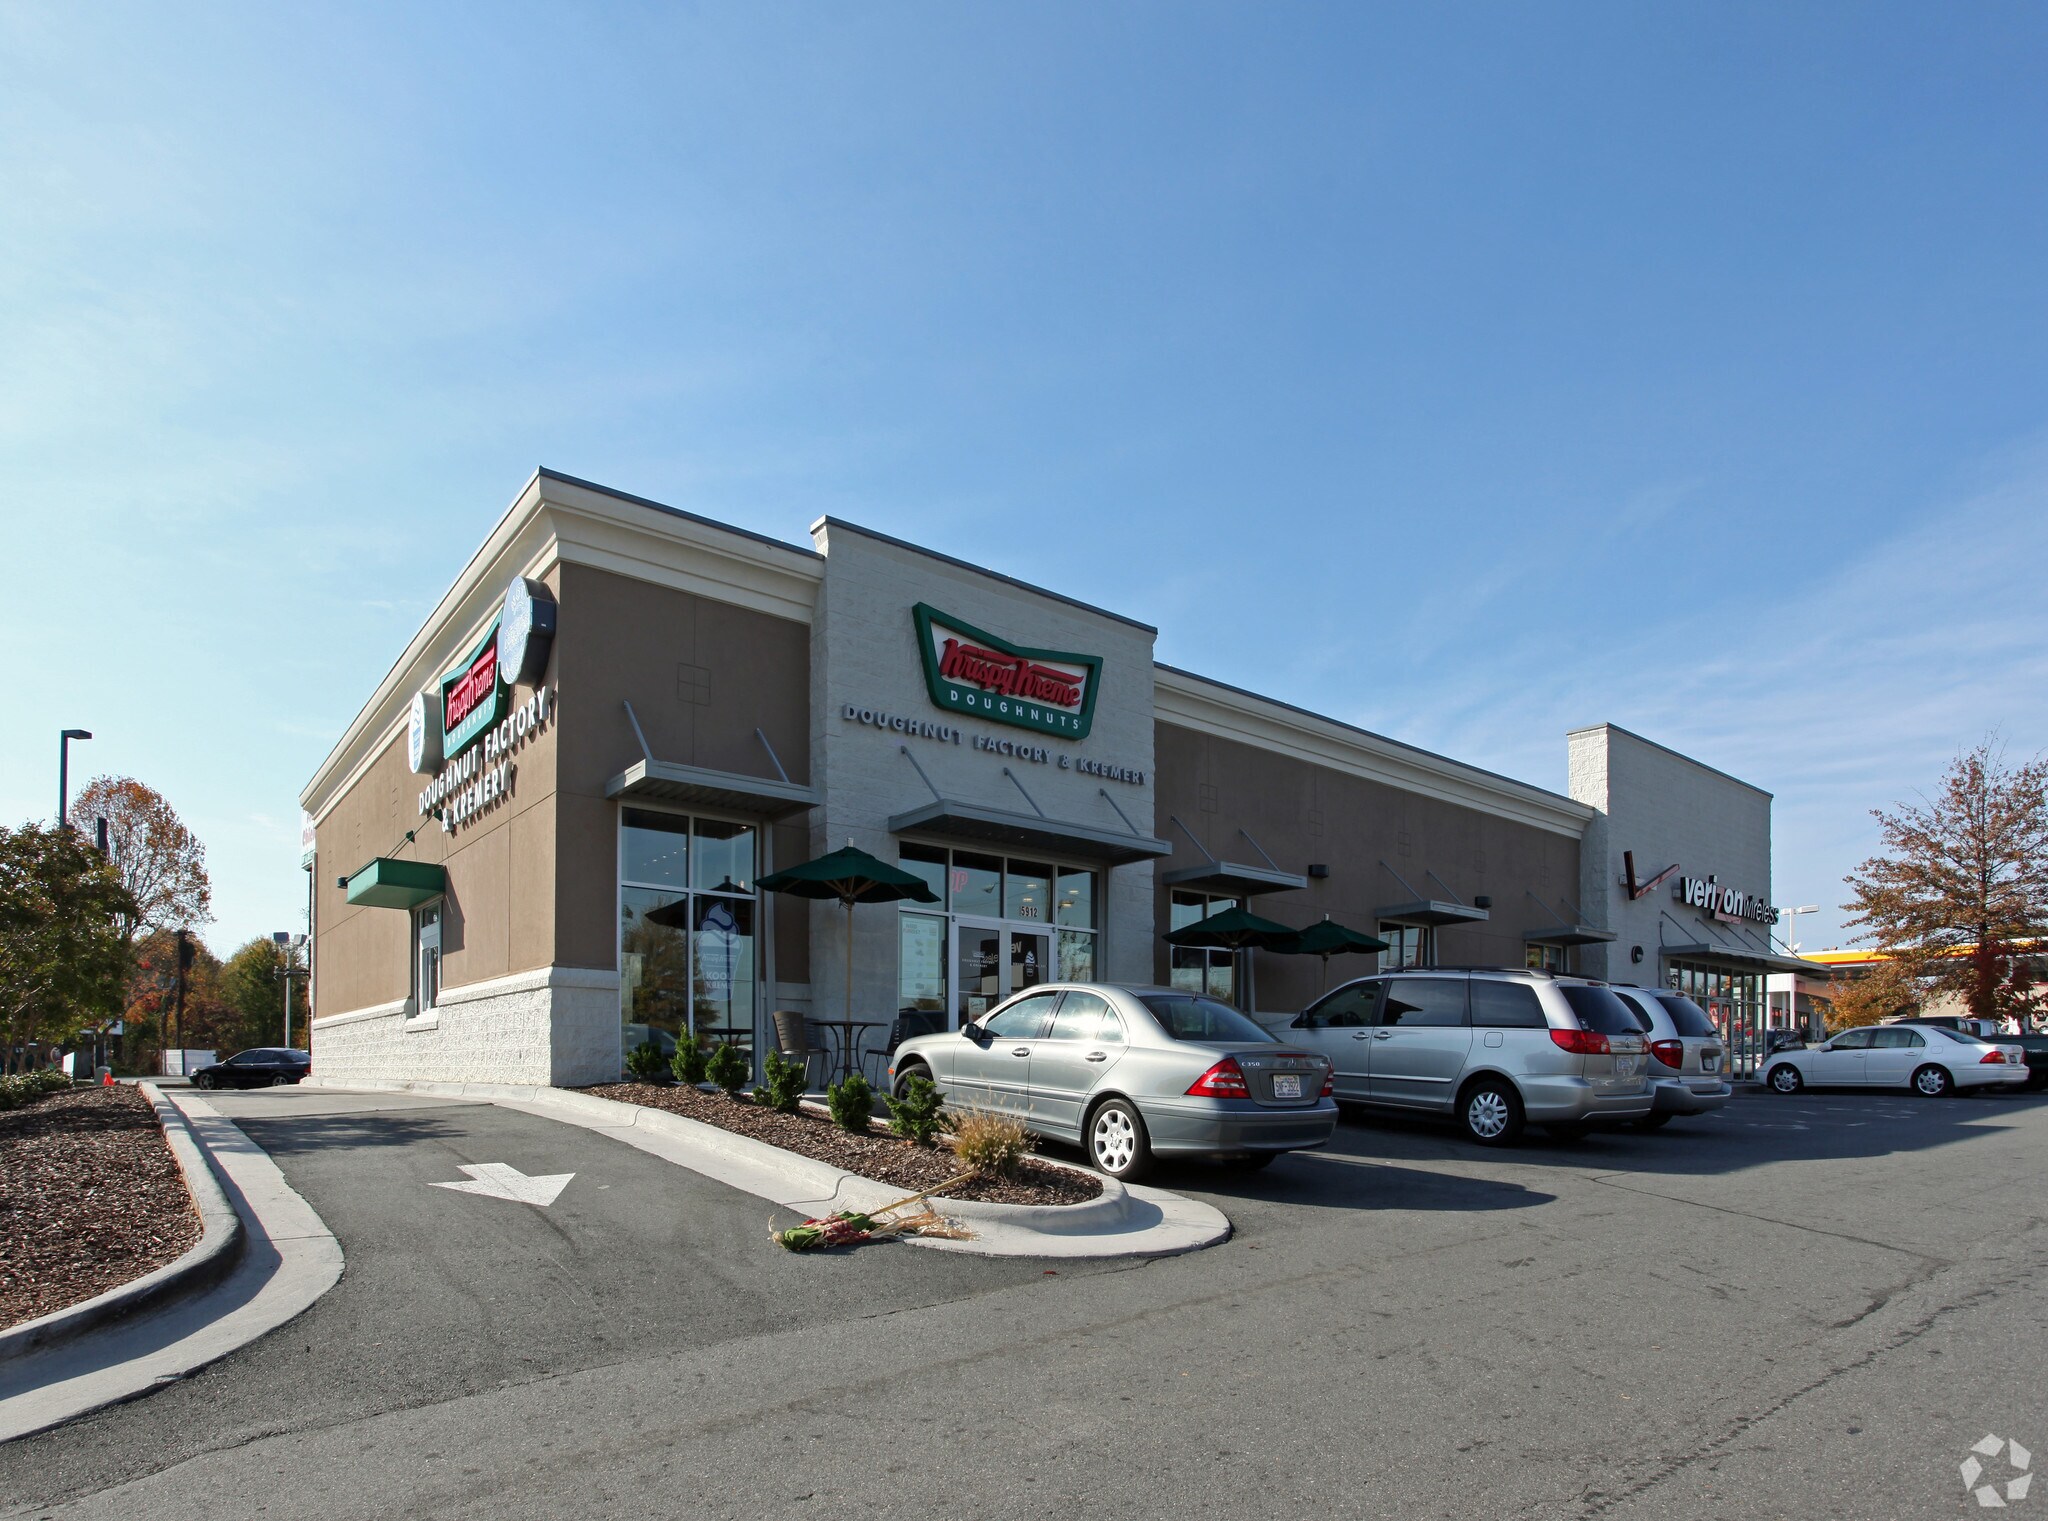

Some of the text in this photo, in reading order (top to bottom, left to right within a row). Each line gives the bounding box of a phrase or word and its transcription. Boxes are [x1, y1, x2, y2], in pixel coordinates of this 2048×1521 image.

[939, 637, 1085, 708] Krispy Kreme
[447, 699, 492, 748] DOUGHNUTS
[950, 689, 1079, 730] DOUGHNUTS
[418, 744, 478, 816] DOUGHNUT
[484, 685, 547, 763] FACTORY
[843, 703, 1148, 786] DOUGHNUT FACTORY & KREMERY
[441, 758, 508, 833] & KREMERY
[1021, 905, 1038, 918] 5912
[1683, 875, 1743, 925] verizon
